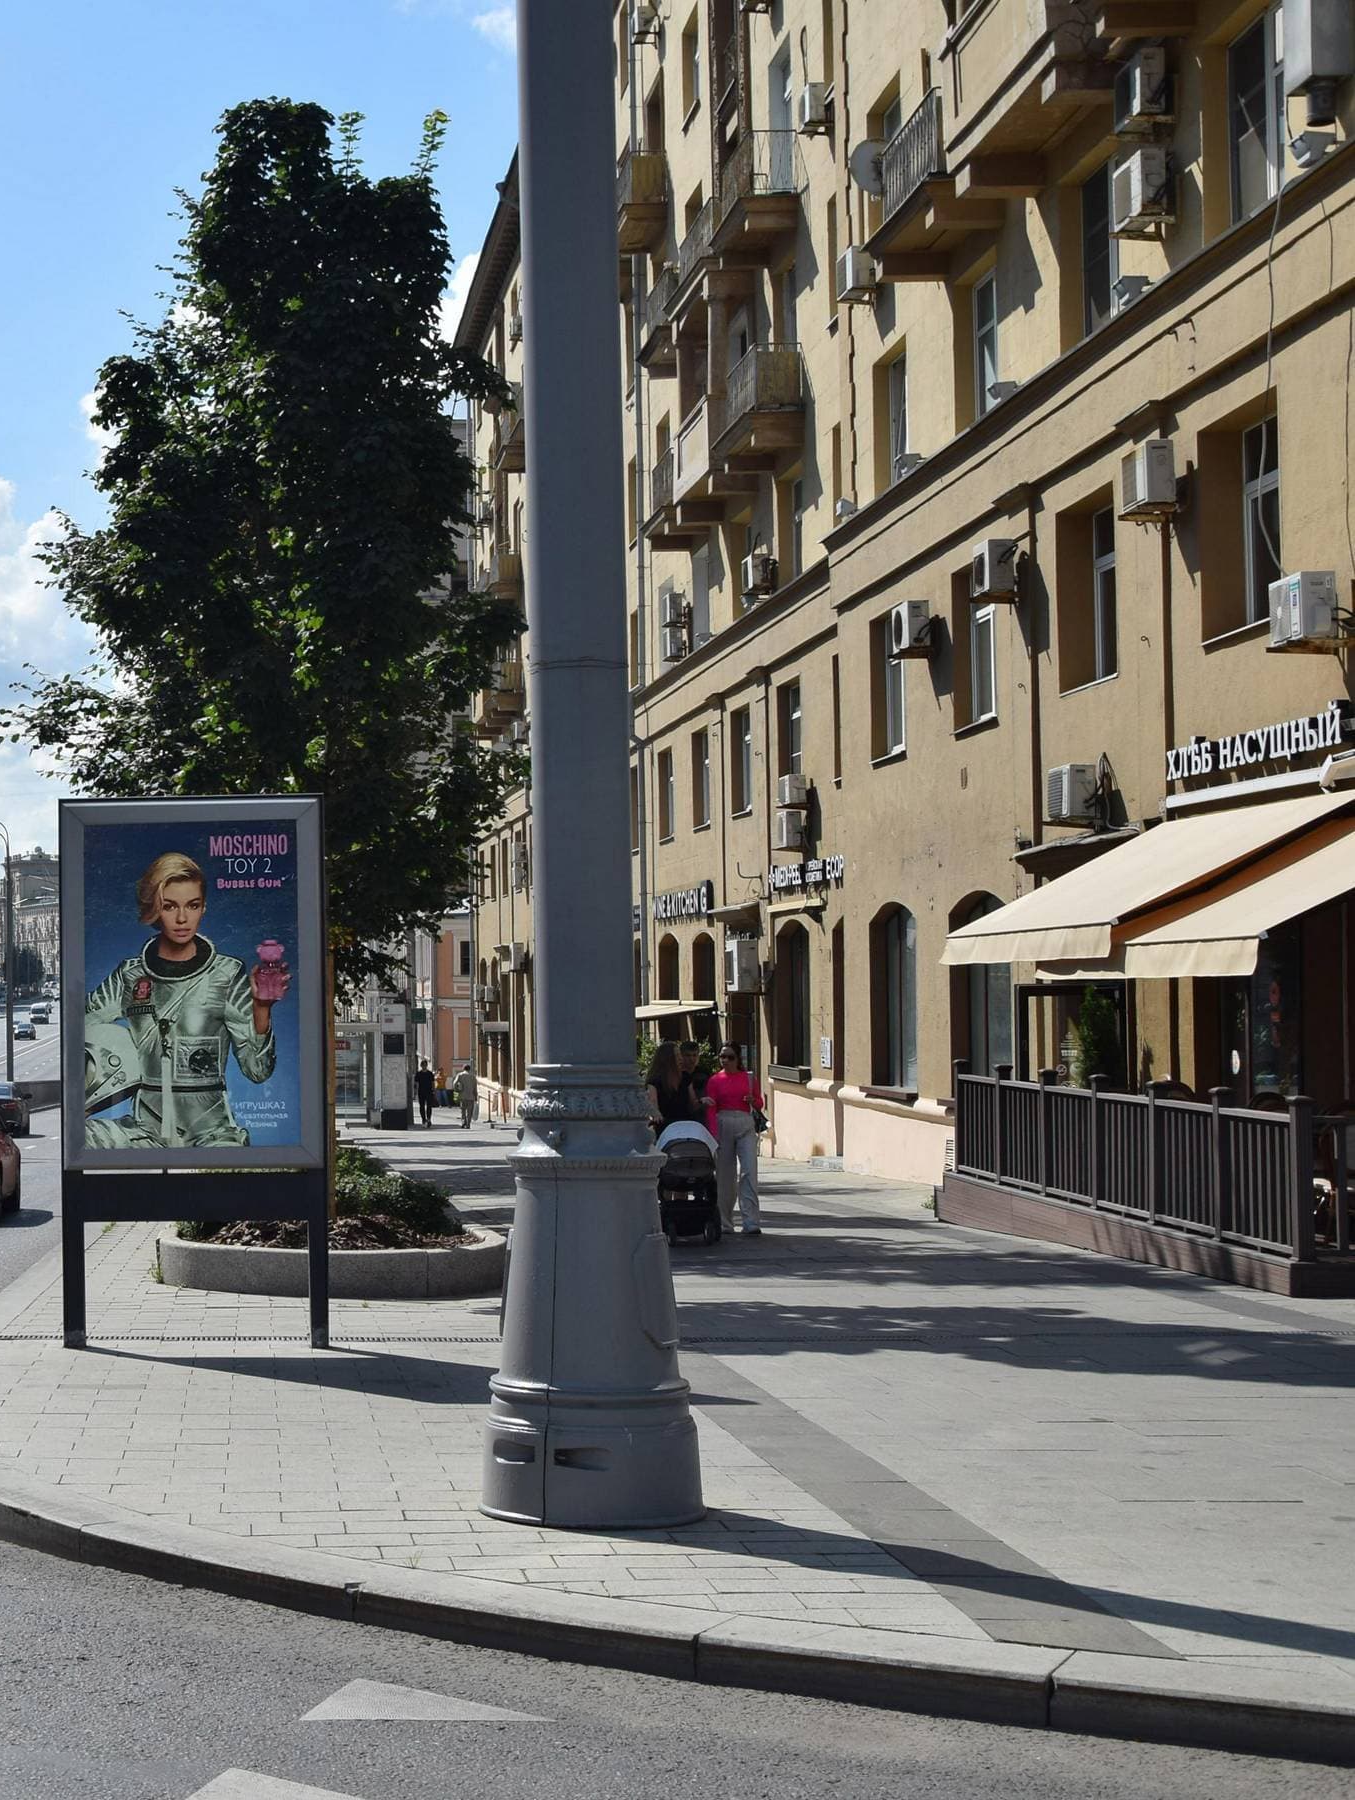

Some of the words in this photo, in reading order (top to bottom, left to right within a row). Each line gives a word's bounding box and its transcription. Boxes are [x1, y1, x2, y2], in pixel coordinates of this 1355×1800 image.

[1218, 700, 1342, 770] НАСУЩНЫЙ
[209, 834, 288, 856] MOSCHINO
[224, 858, 257, 873] TOY
[263, 857, 272, 873] 2
